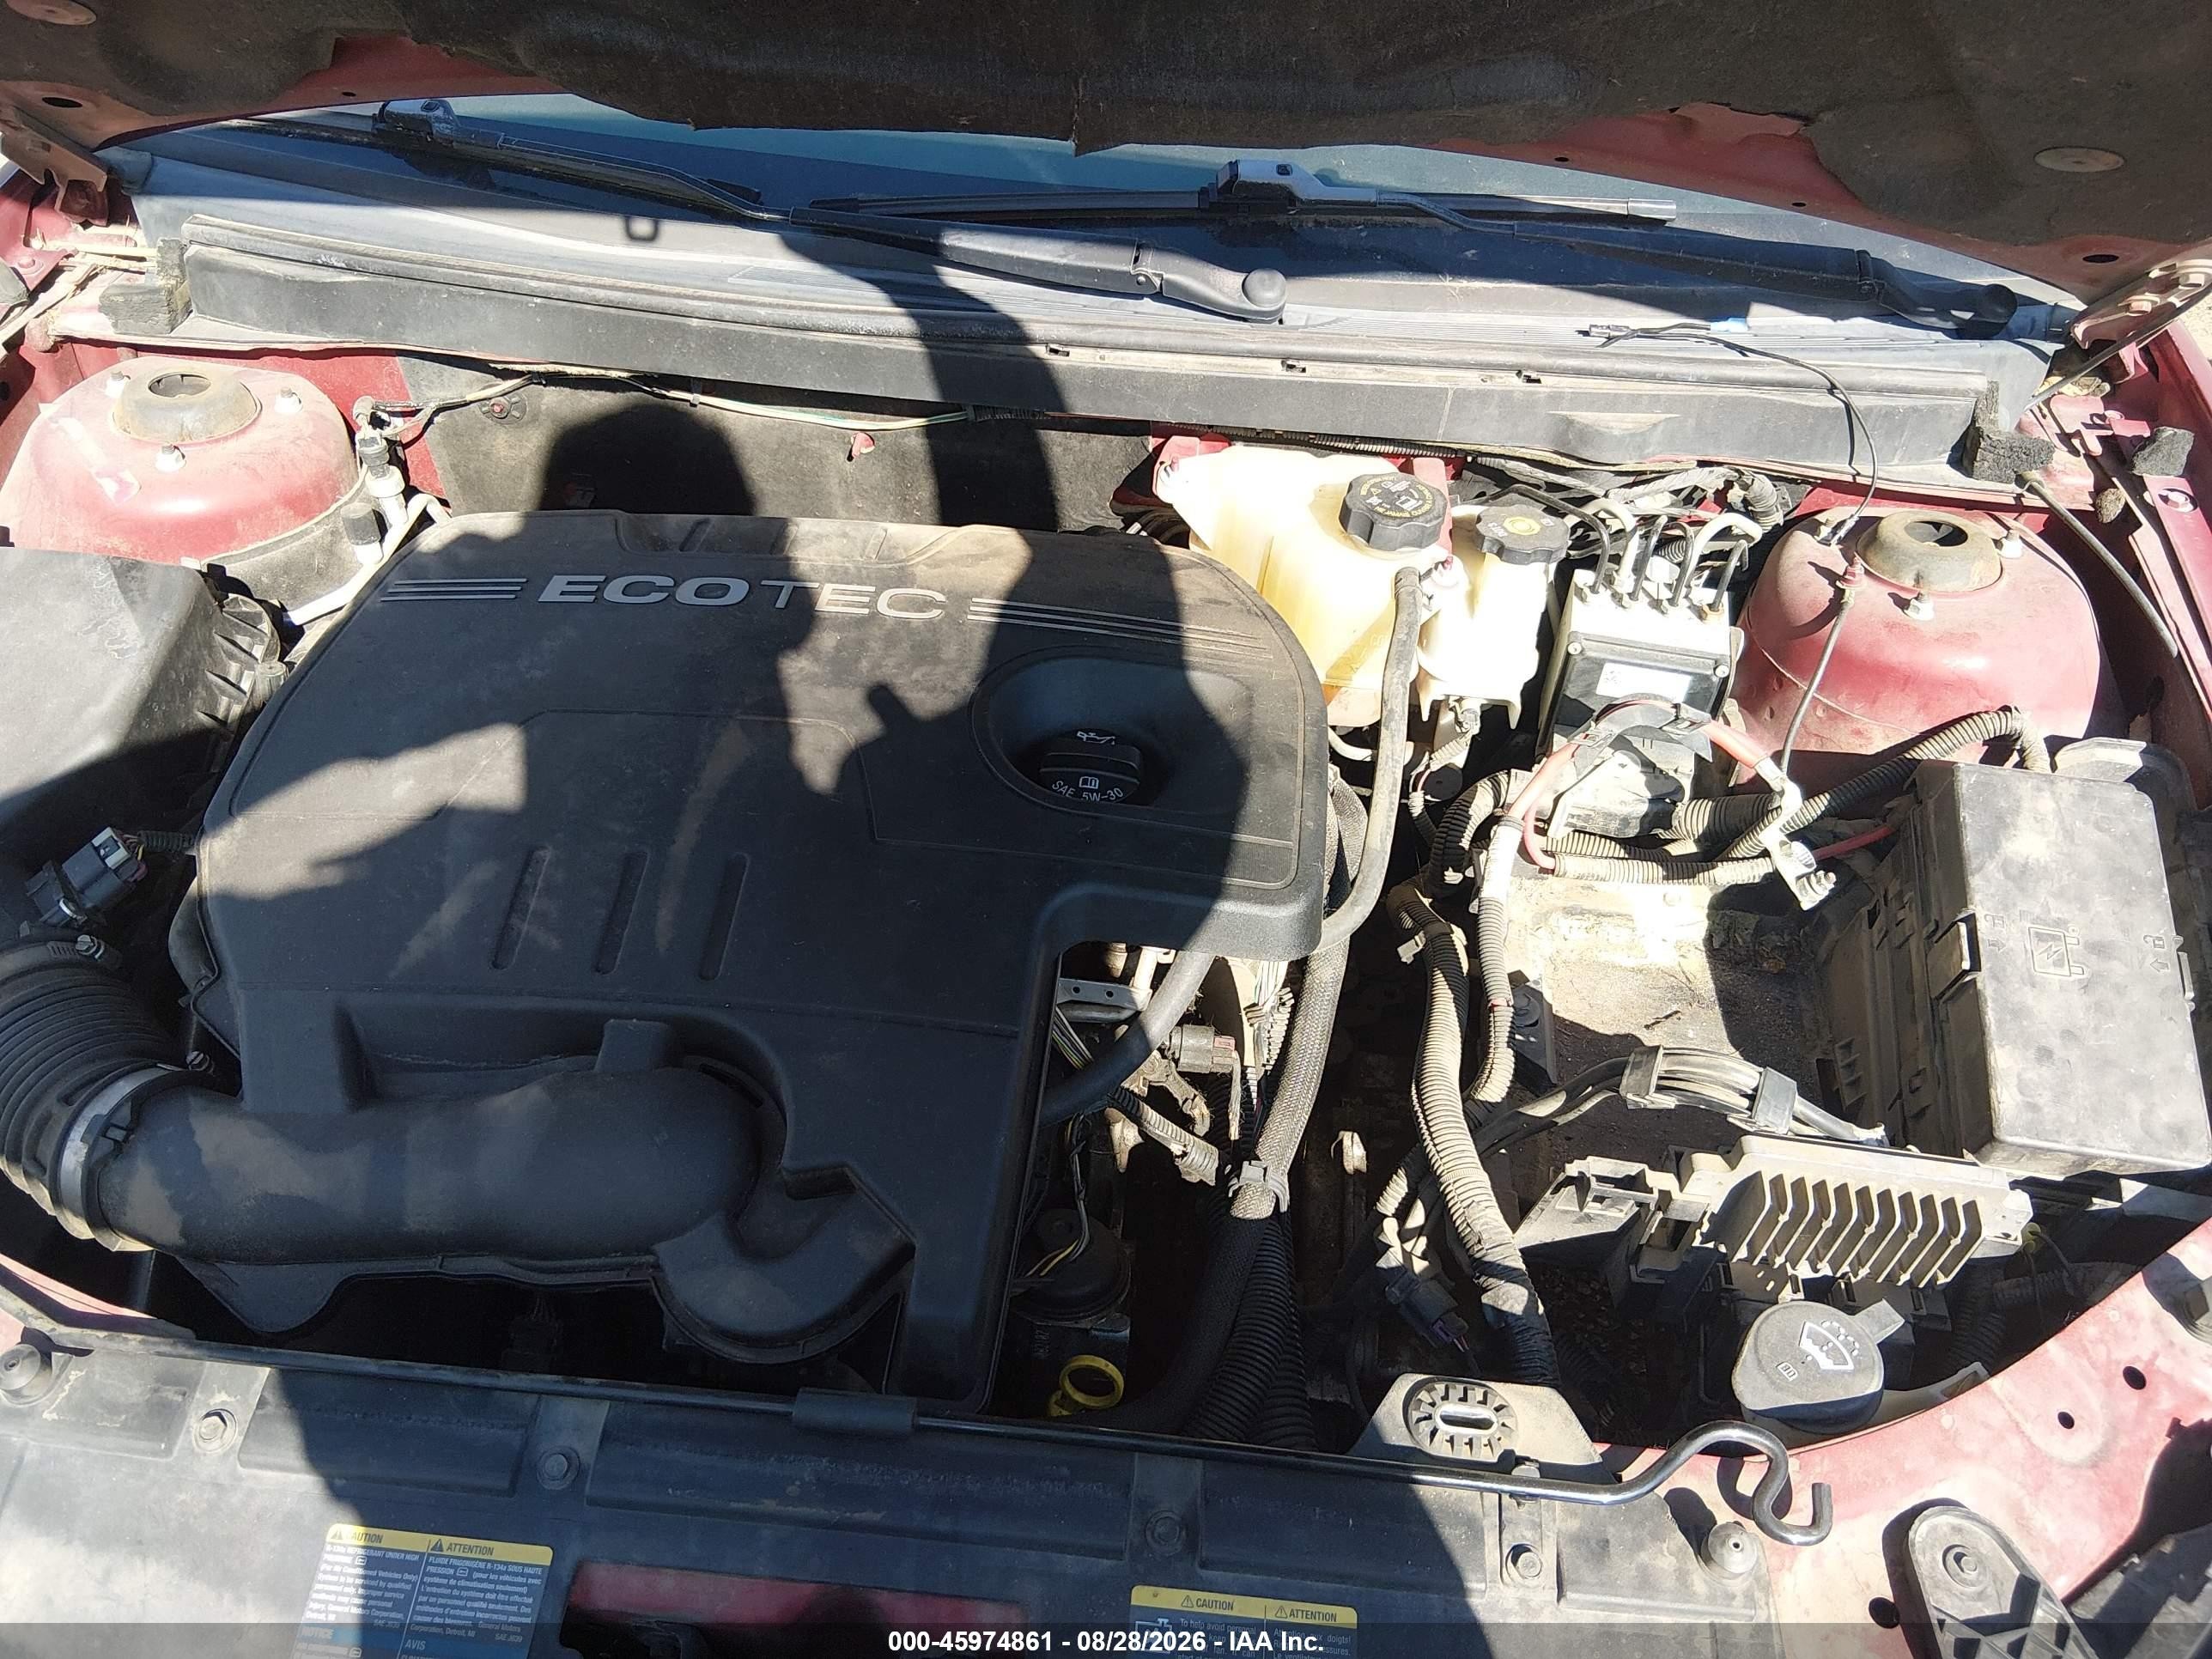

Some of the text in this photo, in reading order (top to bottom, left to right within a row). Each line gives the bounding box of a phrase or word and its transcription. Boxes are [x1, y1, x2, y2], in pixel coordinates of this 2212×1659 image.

[539, 574, 947, 620] ECOTEC
[1052, 781, 1123, 801] SAE 5W-30
[447, 1542, 494, 1556] ATTENTION
[1196, 1598, 1234, 1611] CAUTION
[1289, 1608, 1337, 1622] ATTENTION
[405, 1639, 426, 1650] AVIS
